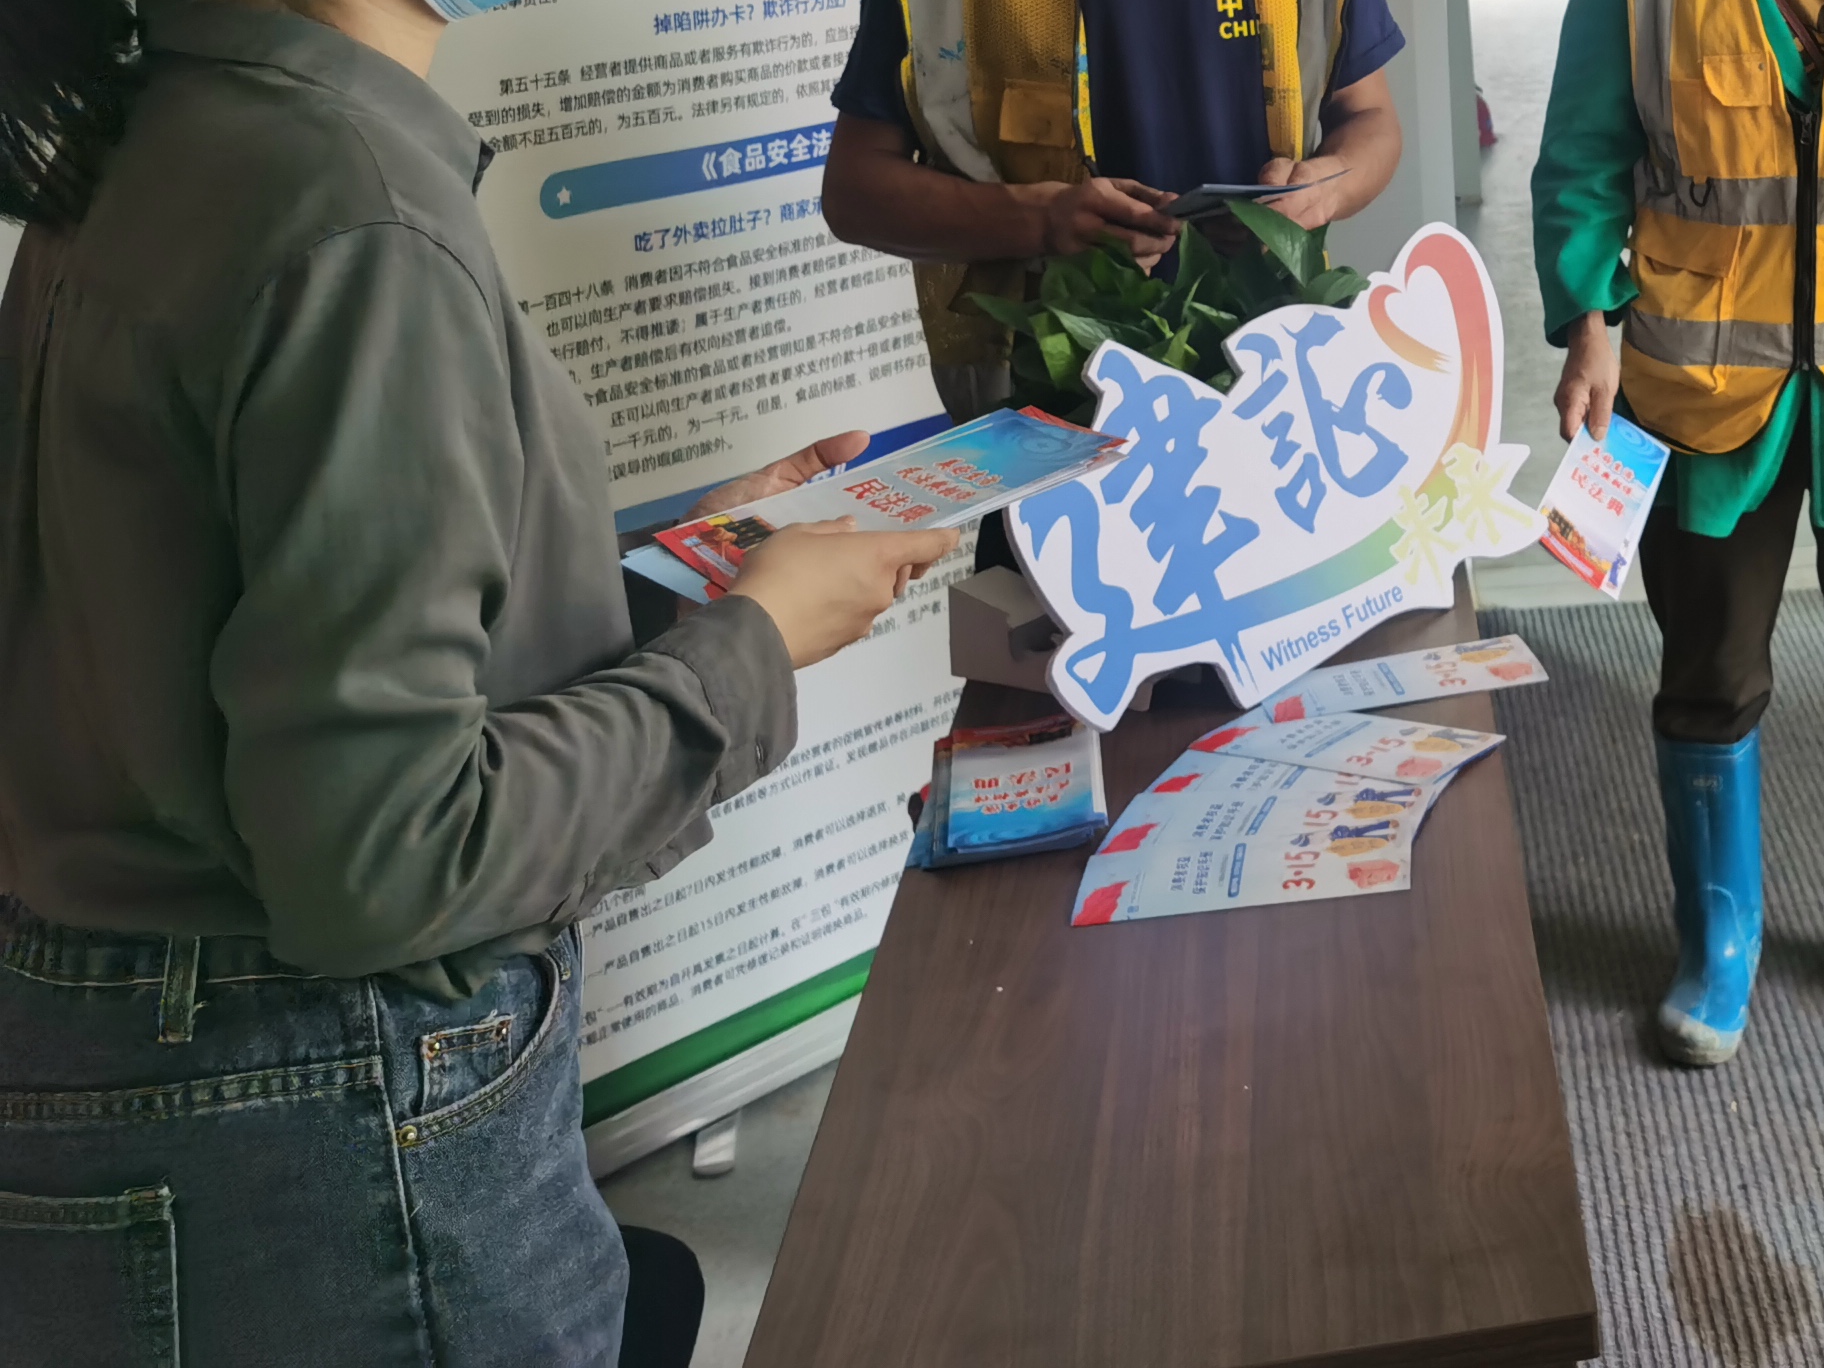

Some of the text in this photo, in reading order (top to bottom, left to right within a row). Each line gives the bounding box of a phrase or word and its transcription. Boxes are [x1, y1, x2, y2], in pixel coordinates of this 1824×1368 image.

[1219, 19, 1260, 40] CHI
[488, 80, 845, 155] 金额不足五百元的，为五百元。法律另有规定的，依照其
[1570, 466, 1626, 517] 民法典
[1260, 583, 1406, 673] Witness Future
